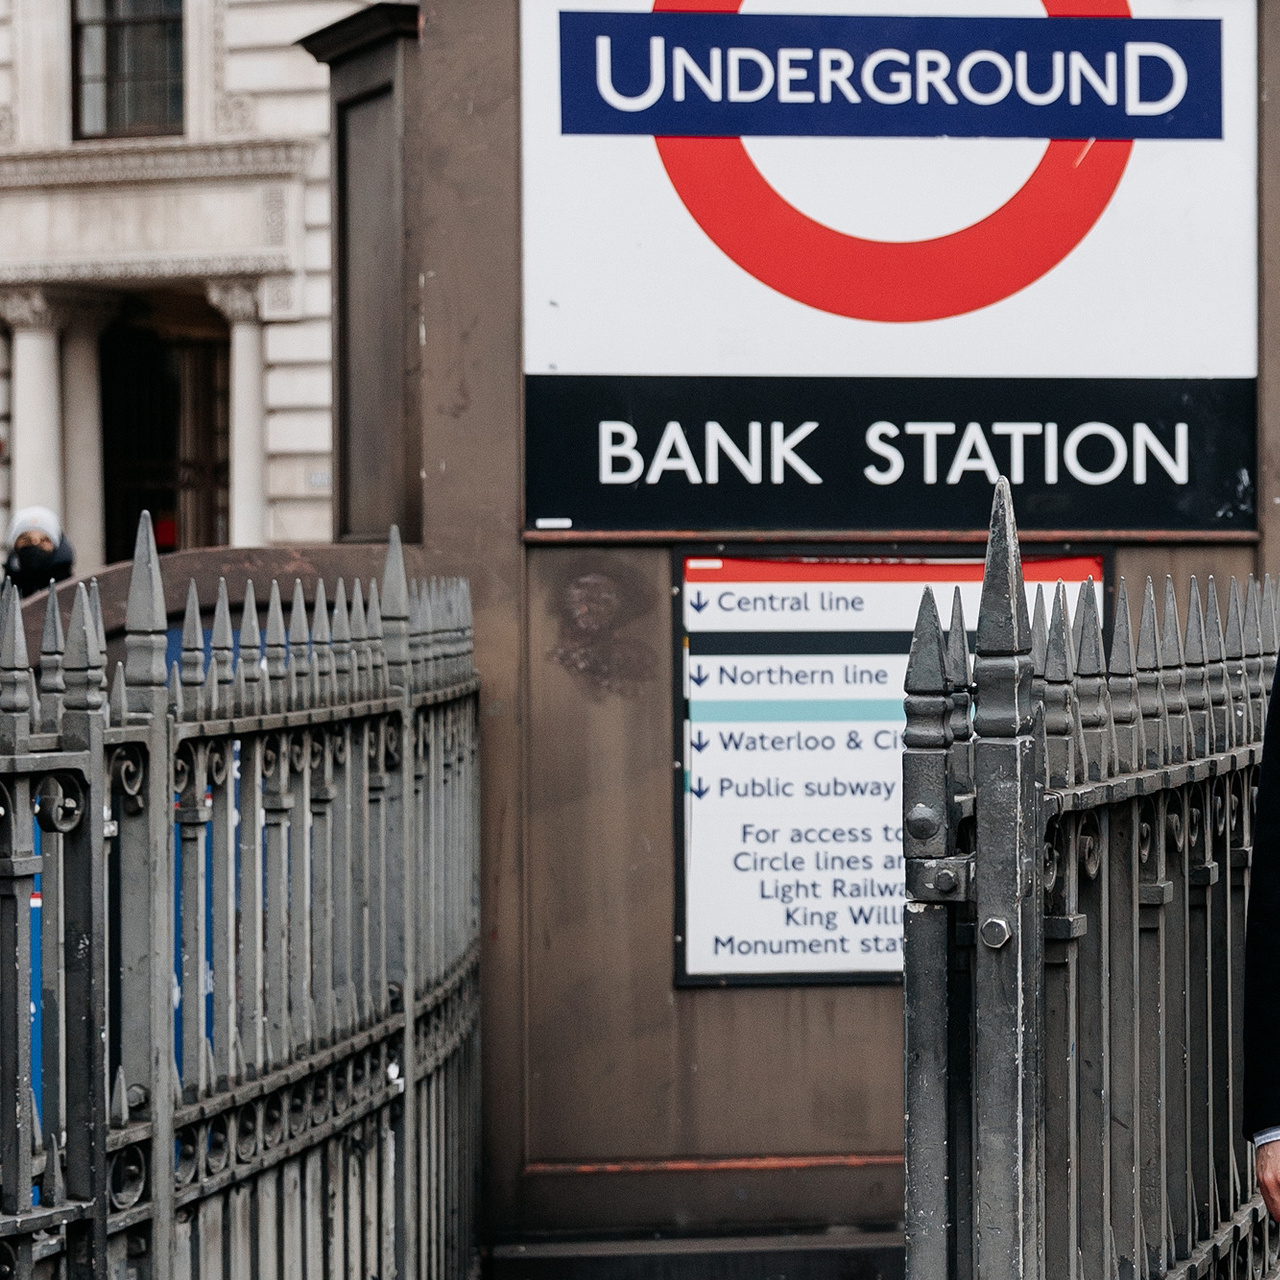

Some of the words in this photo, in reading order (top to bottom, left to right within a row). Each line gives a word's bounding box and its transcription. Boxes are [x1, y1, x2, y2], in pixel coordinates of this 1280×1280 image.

[596, 36, 1187, 115] UNDERGROUND
[599, 421, 822, 483] BANK
[865, 422, 1188, 484] STATION
[718, 592, 809, 612] Central
[821, 592, 864, 611] line
[719, 665, 833, 685] Northern
[845, 665, 887, 684] line
[719, 732, 835, 751] Waterloo
[846, 730, 862, 750] &
[720, 778, 793, 797] Public
[805, 777, 895, 801] subway
[742, 824, 780, 844] For
[790, 828, 872, 843] access
[733, 852, 805, 872] Circle
[815, 851, 873, 871] lines
[760, 879, 821, 904] Light
[785, 906, 838, 931] King
[714, 936, 849, 955] Monument
